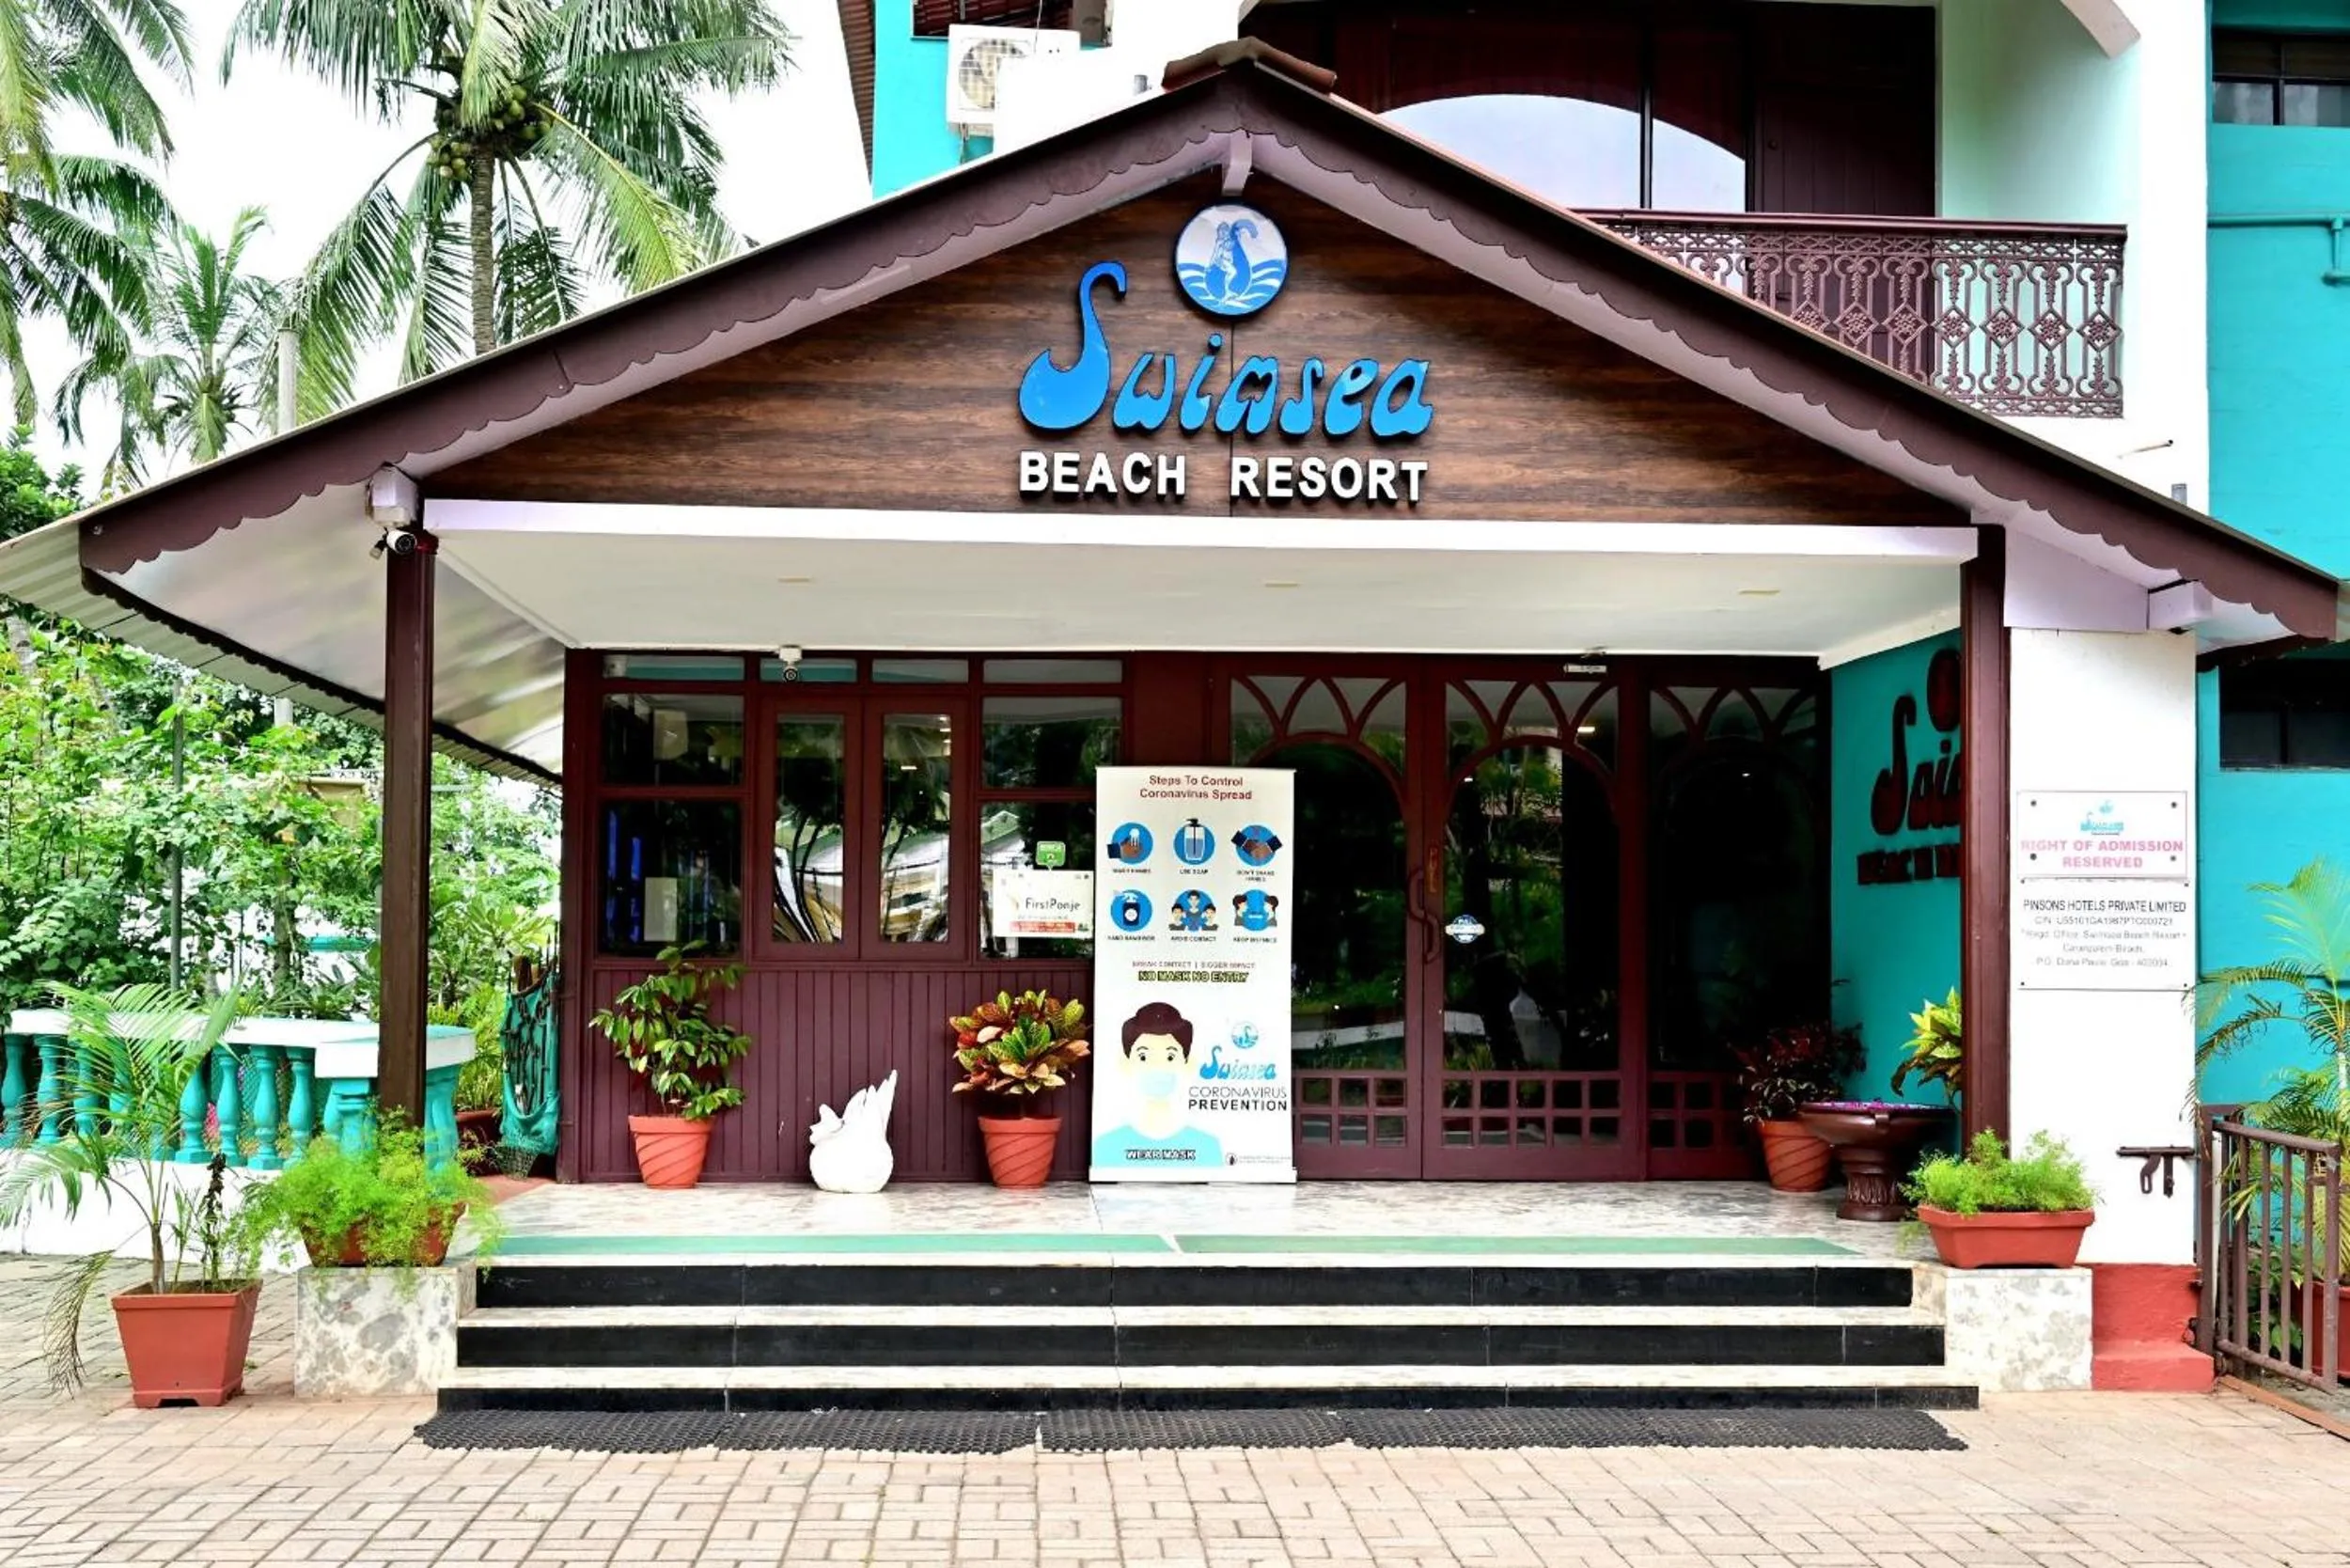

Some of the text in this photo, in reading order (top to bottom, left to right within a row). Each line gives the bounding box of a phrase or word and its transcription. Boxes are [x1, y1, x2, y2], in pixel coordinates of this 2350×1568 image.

[1018, 259, 1434, 438] Swimsea
[1019, 449, 1429, 503] BEACH RESORT
[1149, 775, 1244, 787] Steps To Control
[1139, 788, 1252, 801] Coronavirus Spread
[2020, 839, 2184, 853] RIGHT OF ADMISSION
[2062, 856, 2143, 869] RESERVED
[2023, 899, 2187, 914] PINSONS HOTELS PRIVATE LIMITED
[1137, 970, 1249, 983] NO MASK NO ENTRY
[1188, 1086, 1287, 1099] CORONAVIRUS
[1188, 1099, 1288, 1112] PREVENTION
[1163, 1149, 1197, 1161] MASK
